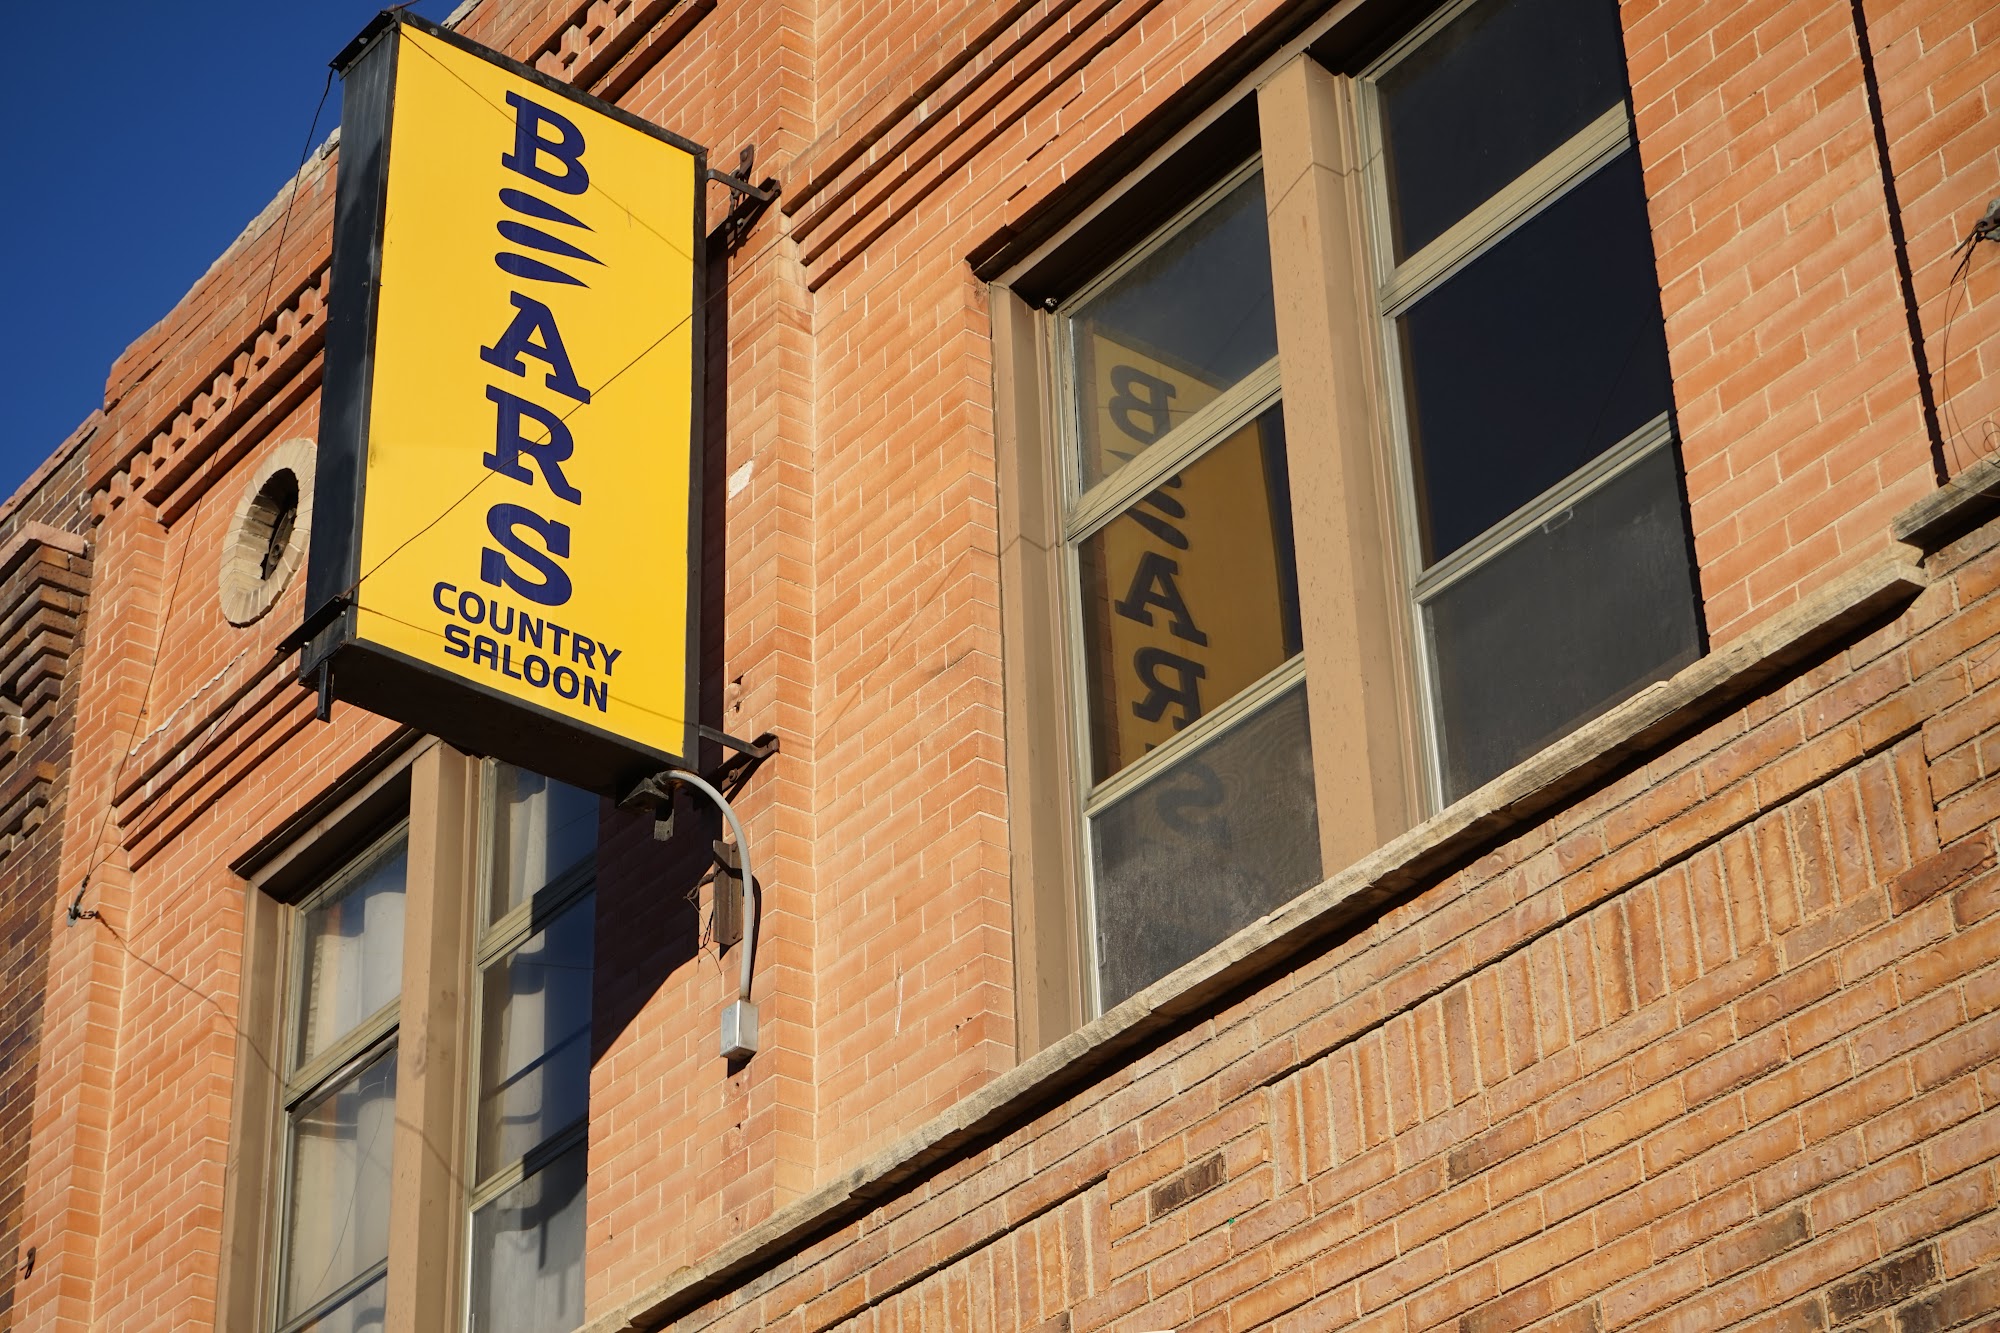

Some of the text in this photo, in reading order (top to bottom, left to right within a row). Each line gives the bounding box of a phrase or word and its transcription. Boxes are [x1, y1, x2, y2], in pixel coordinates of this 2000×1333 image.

[480, 90, 605, 606] BEARS
[433, 582, 622, 677] COUNTRY
[444, 623, 608, 713] SALOON
